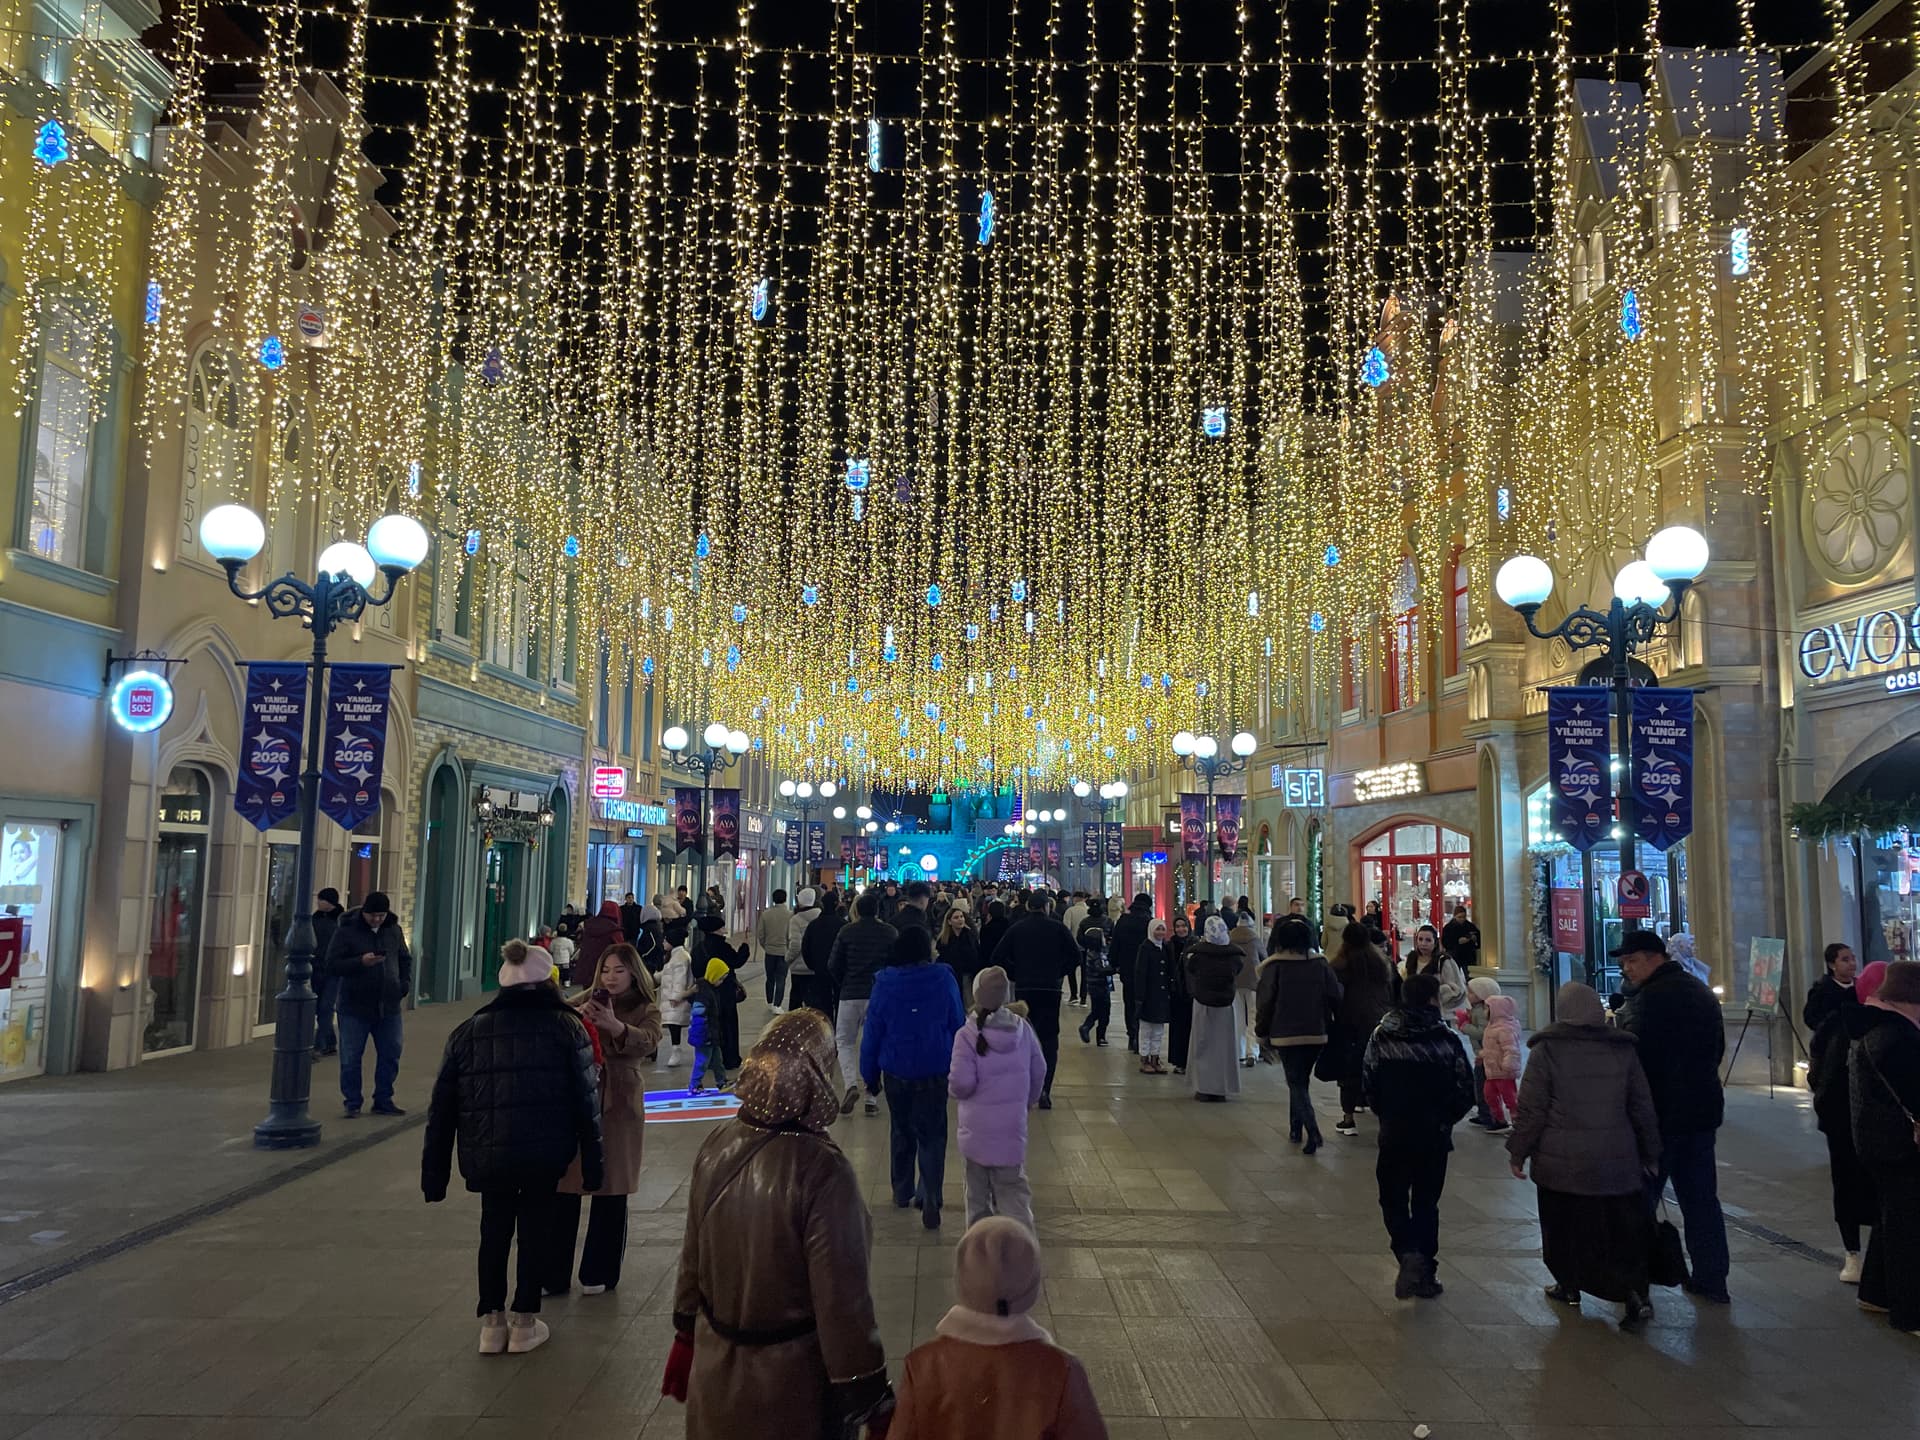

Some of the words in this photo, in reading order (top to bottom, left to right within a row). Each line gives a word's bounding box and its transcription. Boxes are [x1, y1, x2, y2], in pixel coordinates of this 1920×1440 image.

[1799, 603, 1920, 679] evo
[1886, 670, 1920, 690] COS
[263, 696, 289, 704] YANGI
[346, 695, 373, 703] YANGI
[252, 703, 299, 714] YILINGIZ
[335, 703, 383, 714] YILINGIZ
[1565, 719, 1593, 727] YANGI
[1649, 719, 1676, 727] YANGI
[1554, 727, 1604, 737] YILINGIZ
[1639, 726, 1687, 737] YILINGIZ
[251, 751, 290, 764] 2026
[335, 750, 374, 763] 2026
[1560, 773, 1600, 785] 2026
[1641, 772, 1682, 785] 2026
[602, 798, 640, 823] TOSHKENT
[640, 804, 667, 826] PARFUM
[1558, 918, 1578, 931] SALE
